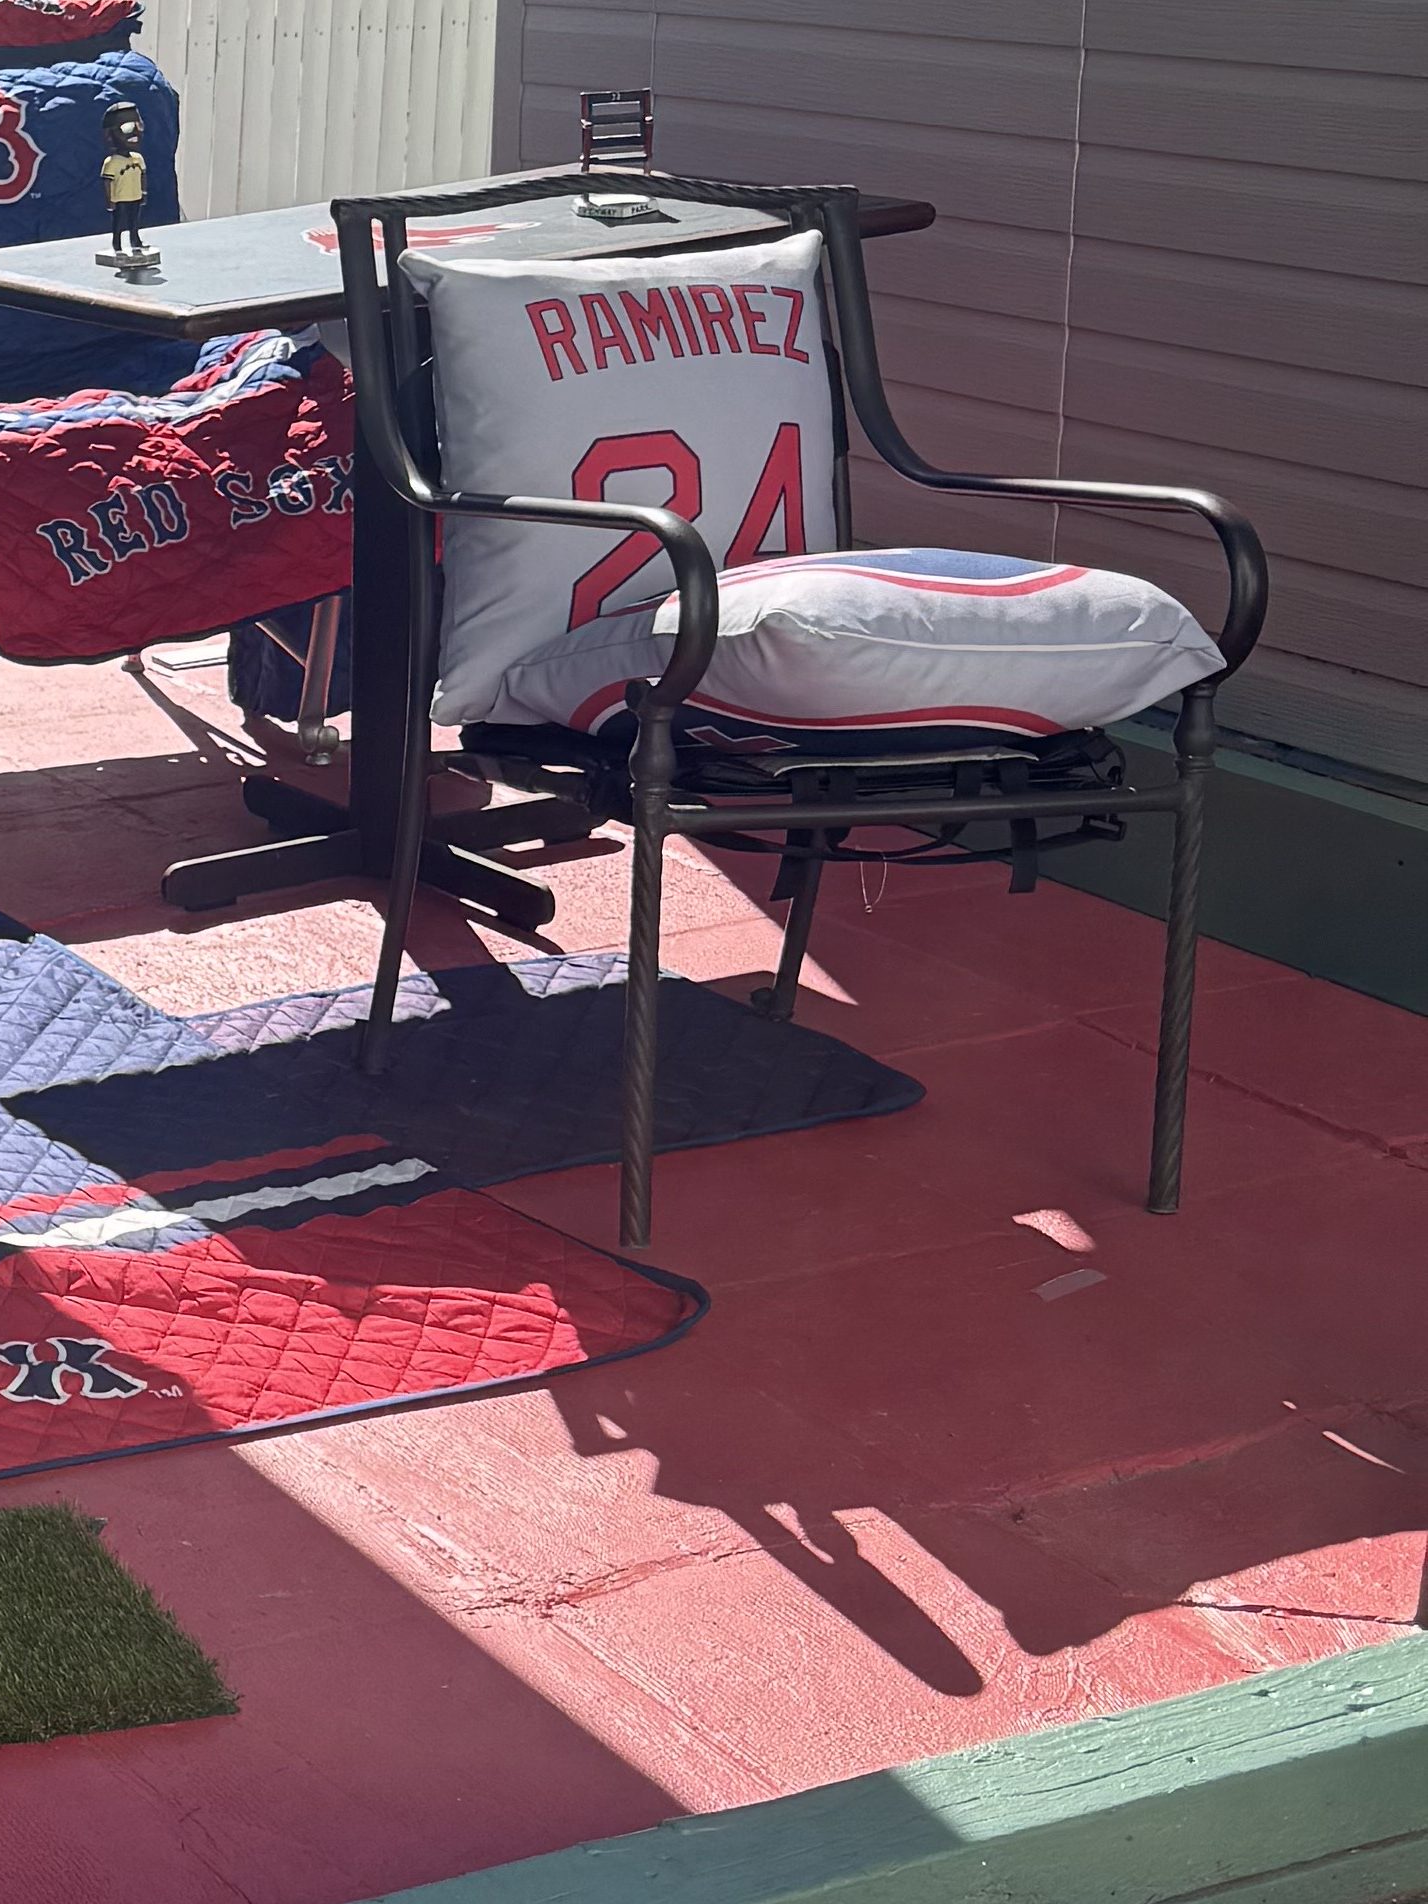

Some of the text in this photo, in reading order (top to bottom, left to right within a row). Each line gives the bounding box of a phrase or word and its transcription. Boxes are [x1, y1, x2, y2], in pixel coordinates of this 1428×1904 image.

[524, 283, 811, 382] RAMIREZ
[36, 481, 189, 587] RED
[568, 421, 811, 632] 24
